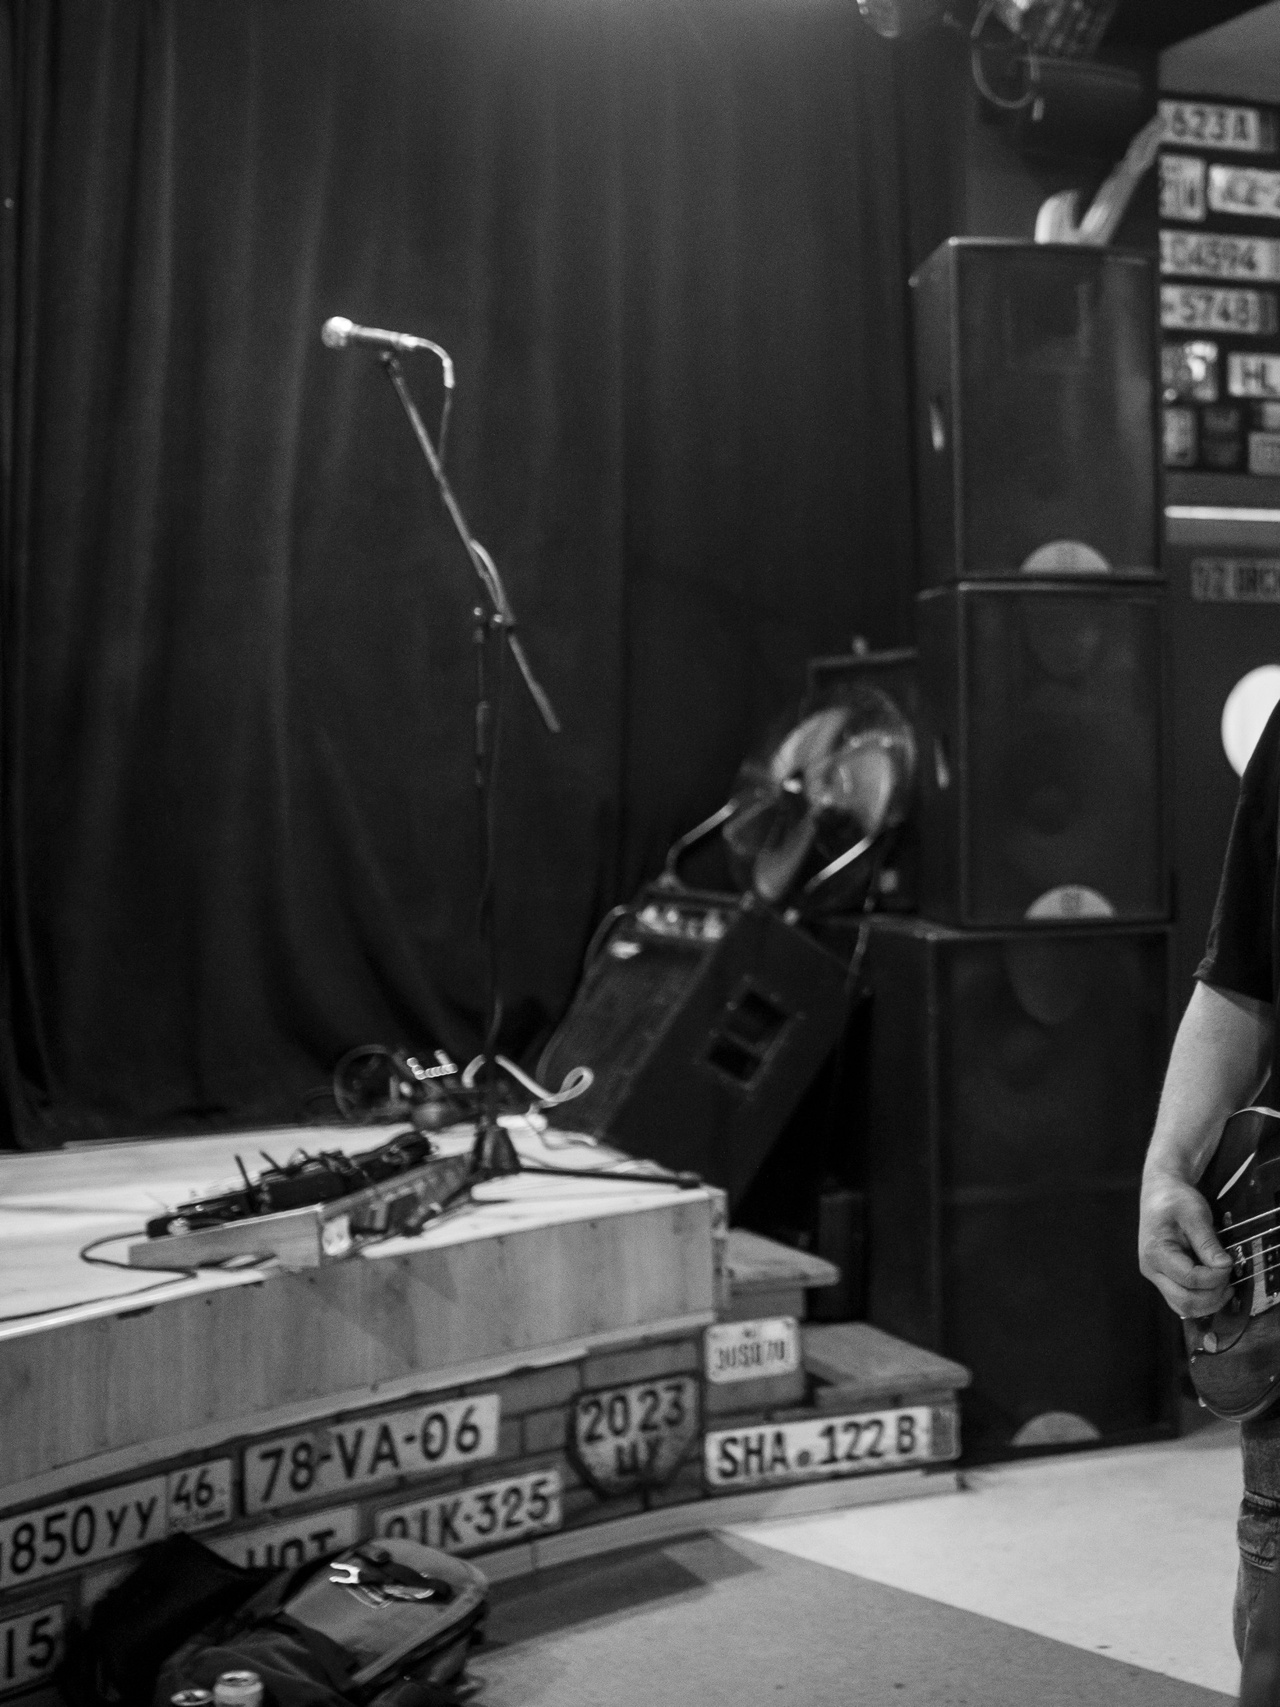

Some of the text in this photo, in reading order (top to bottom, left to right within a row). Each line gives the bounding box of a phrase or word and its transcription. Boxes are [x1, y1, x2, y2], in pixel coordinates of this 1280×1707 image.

[580, 1384, 685, 1444] 2023
[259, 1404, 482, 1504] 78-VA-06
[717, 1430, 790, 1479] SHA
